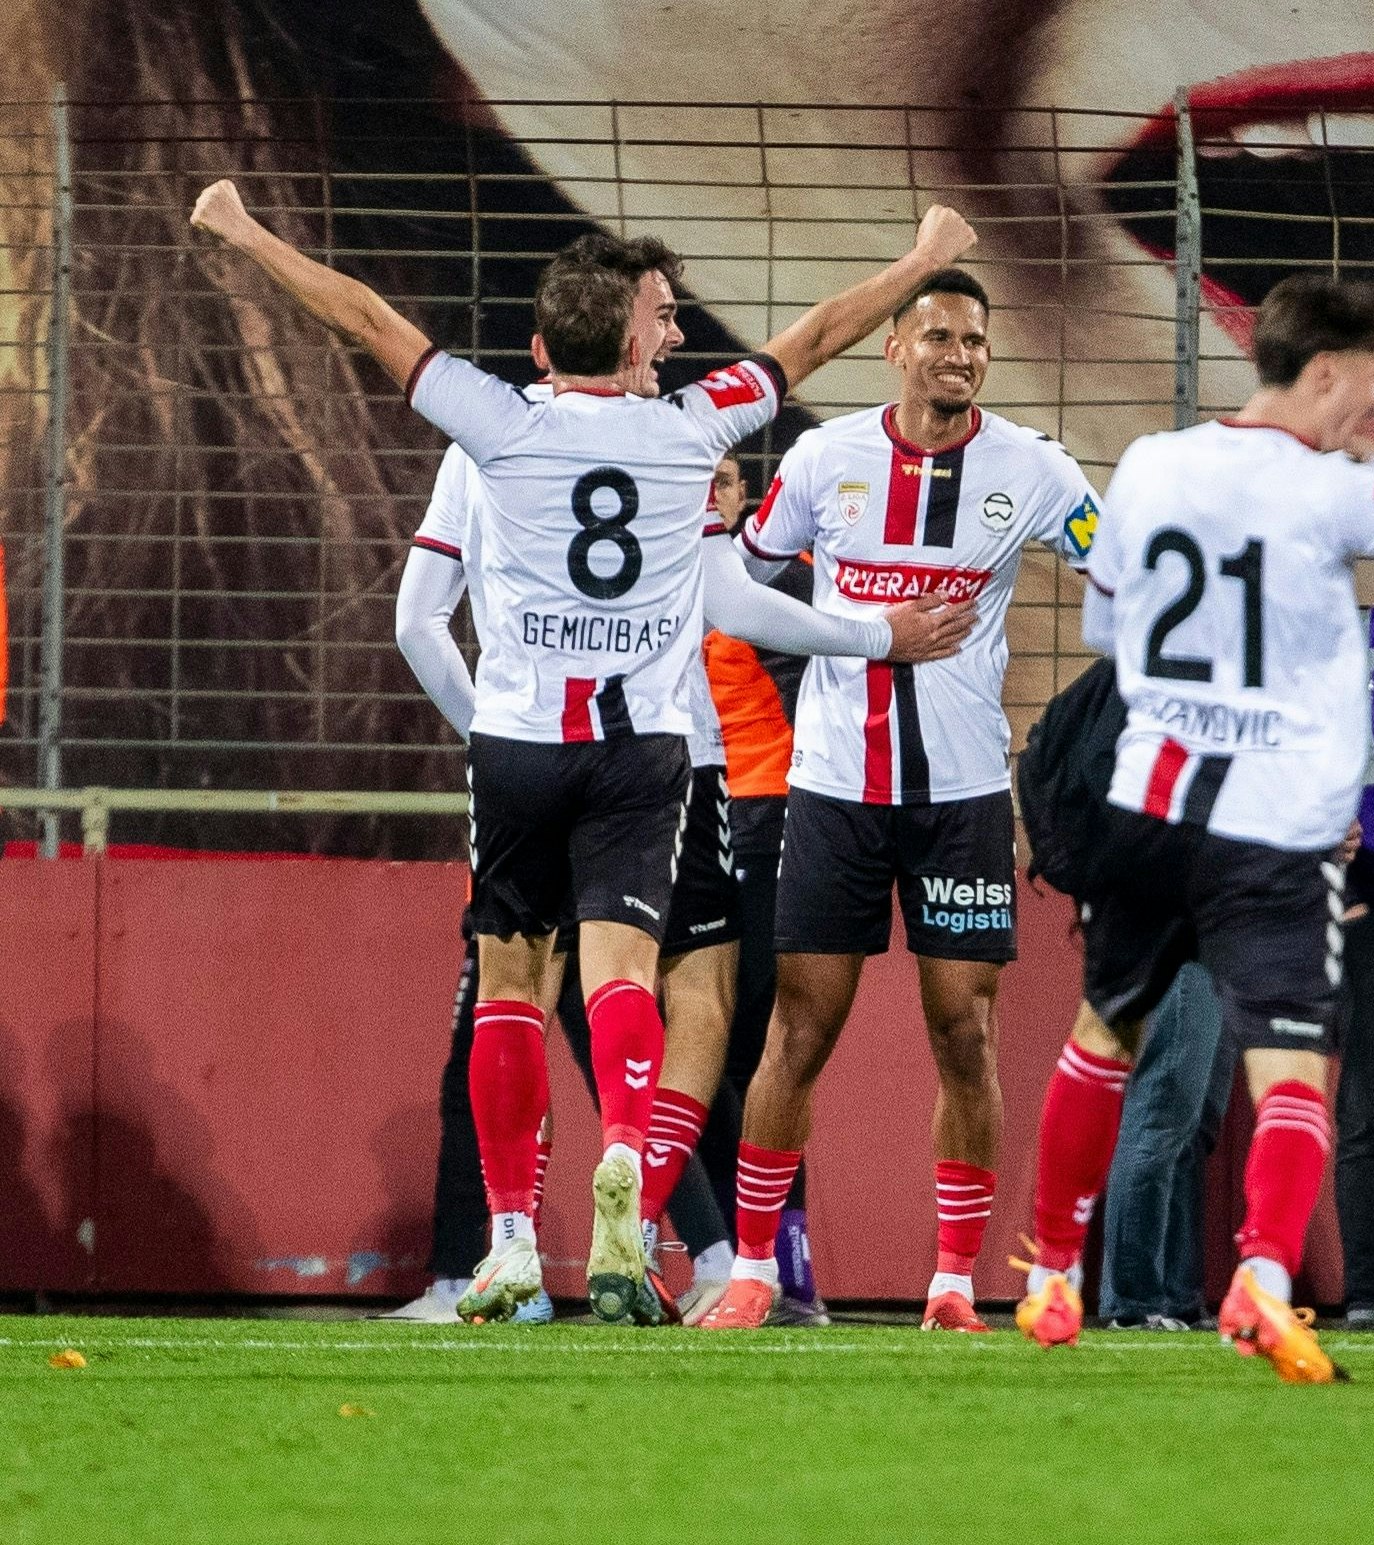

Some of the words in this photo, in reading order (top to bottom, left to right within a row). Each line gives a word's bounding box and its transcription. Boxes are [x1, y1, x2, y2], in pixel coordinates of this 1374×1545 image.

[566, 467, 643, 600] 8
[839, 565, 982, 599] FLYERALARM
[1143, 527, 1265, 688] 21
[921, 877, 1012, 905] Weiss
